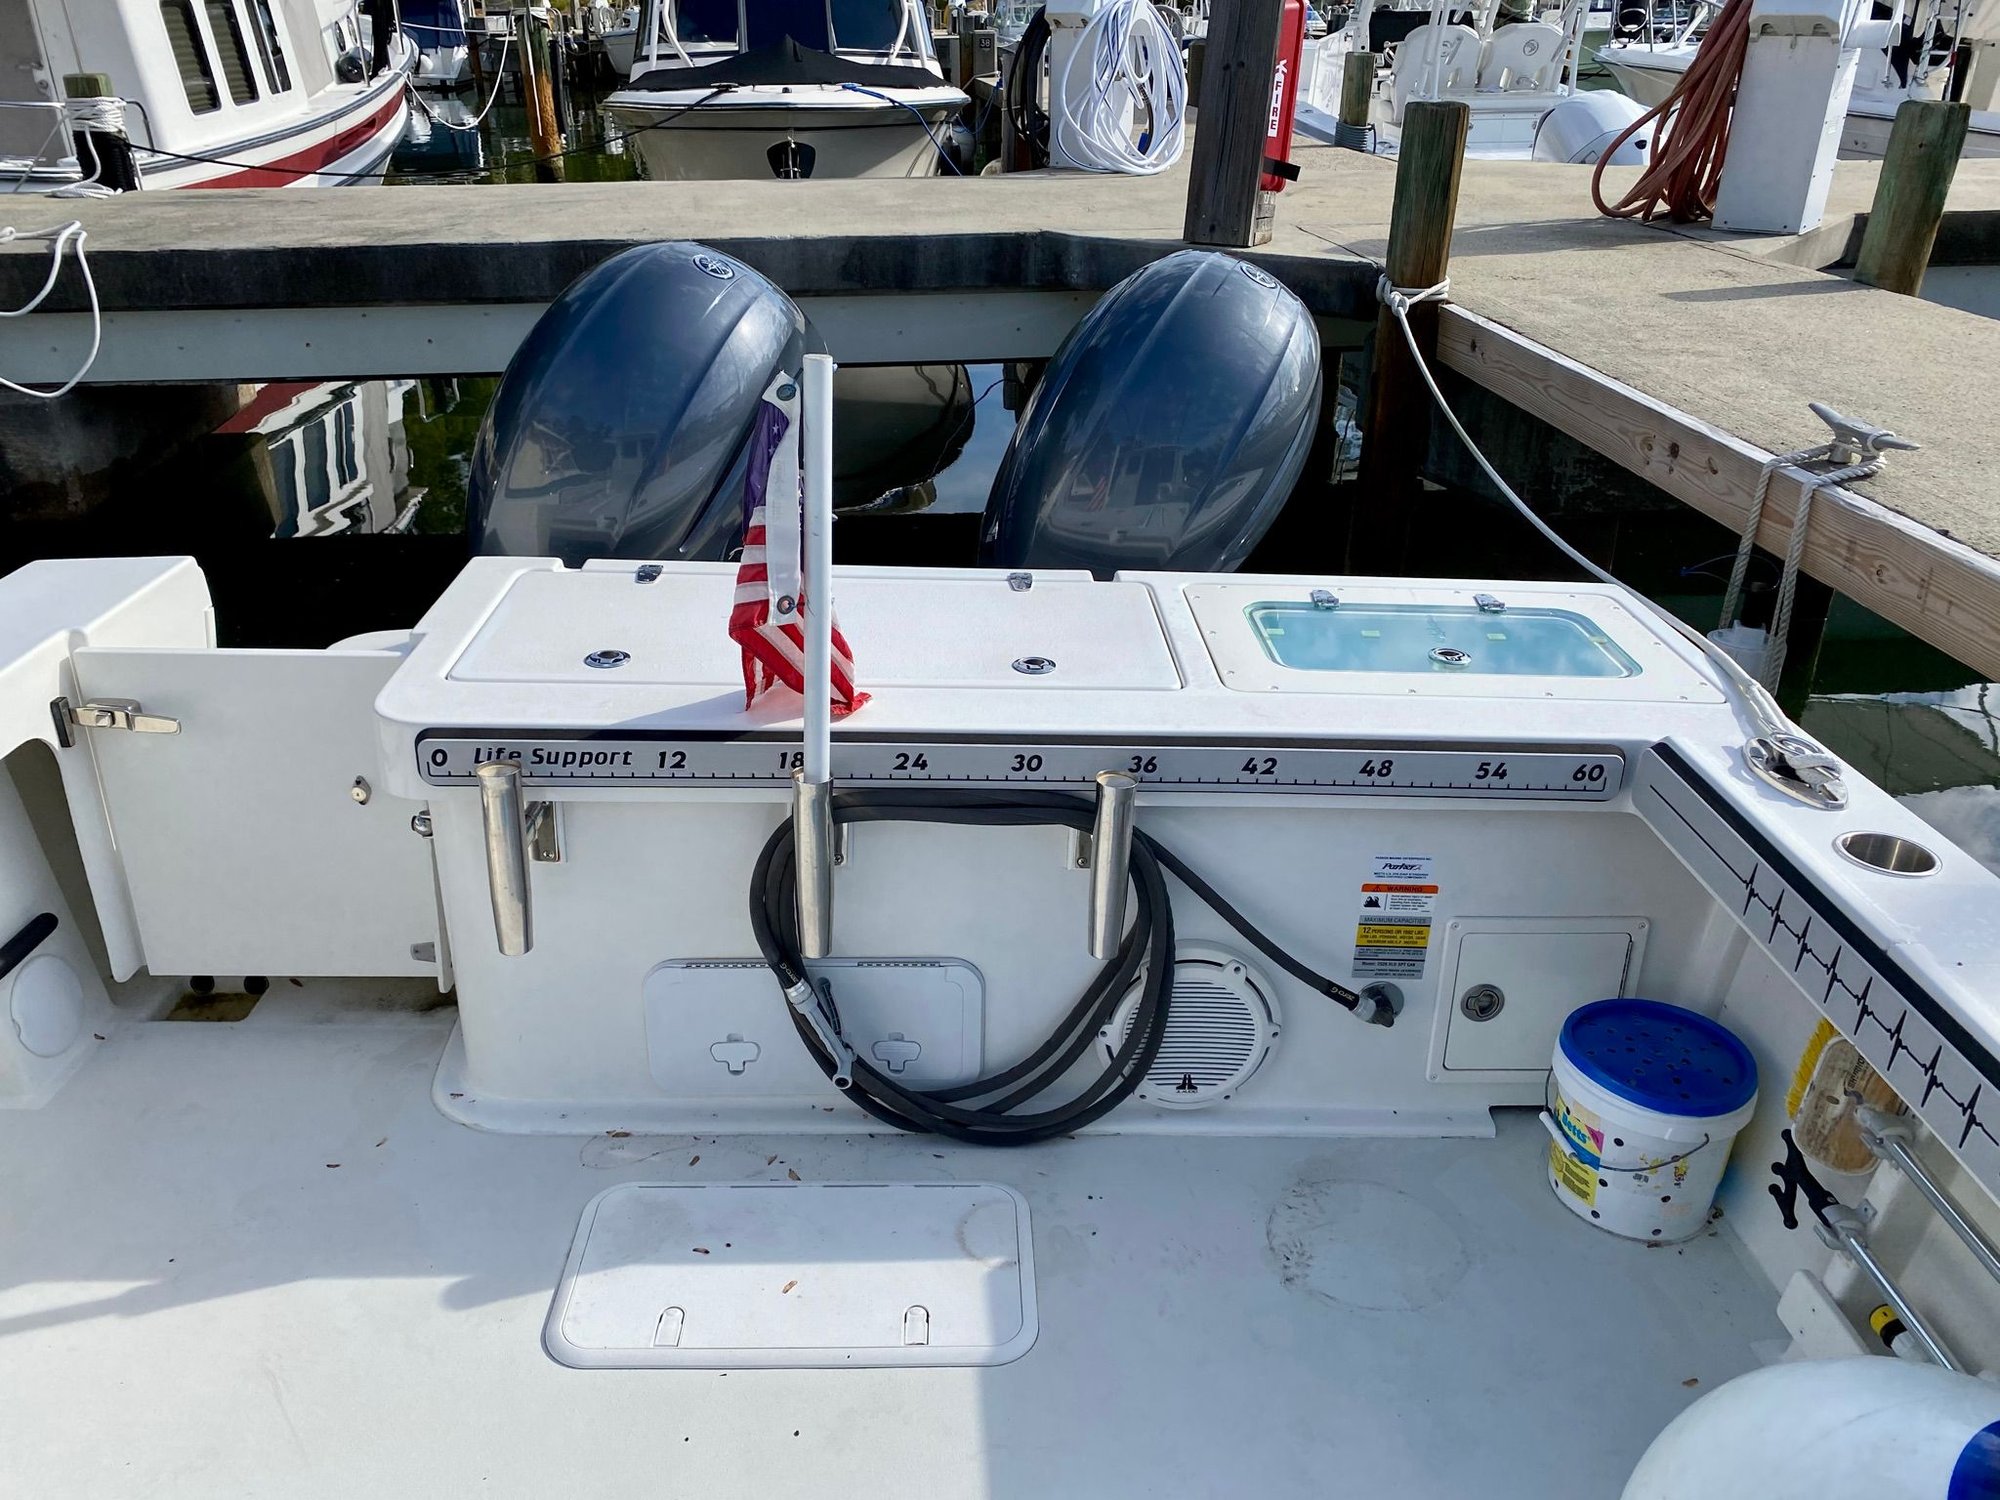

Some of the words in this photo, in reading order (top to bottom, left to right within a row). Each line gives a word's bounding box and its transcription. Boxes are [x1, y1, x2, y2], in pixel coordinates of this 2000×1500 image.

[980, 38, 991, 47] 38
[1270, 80, 1283, 130] FIRE
[474, 747, 522, 764] Life
[530, 747, 633, 768] Support
[657, 750, 688, 770] 12
[779, 751, 804, 769] 18
[892, 751, 929, 771] 24
[1011, 753, 1043, 773] 30
[1128, 754, 1158, 774] 36
[1241, 756, 1277, 776] 42
[1359, 758, 1394, 778] 48
[1474, 761, 1508, 781] 54
[1572, 763, 1605, 783] 60
[1561, 1112, 1587, 1144] Betts
